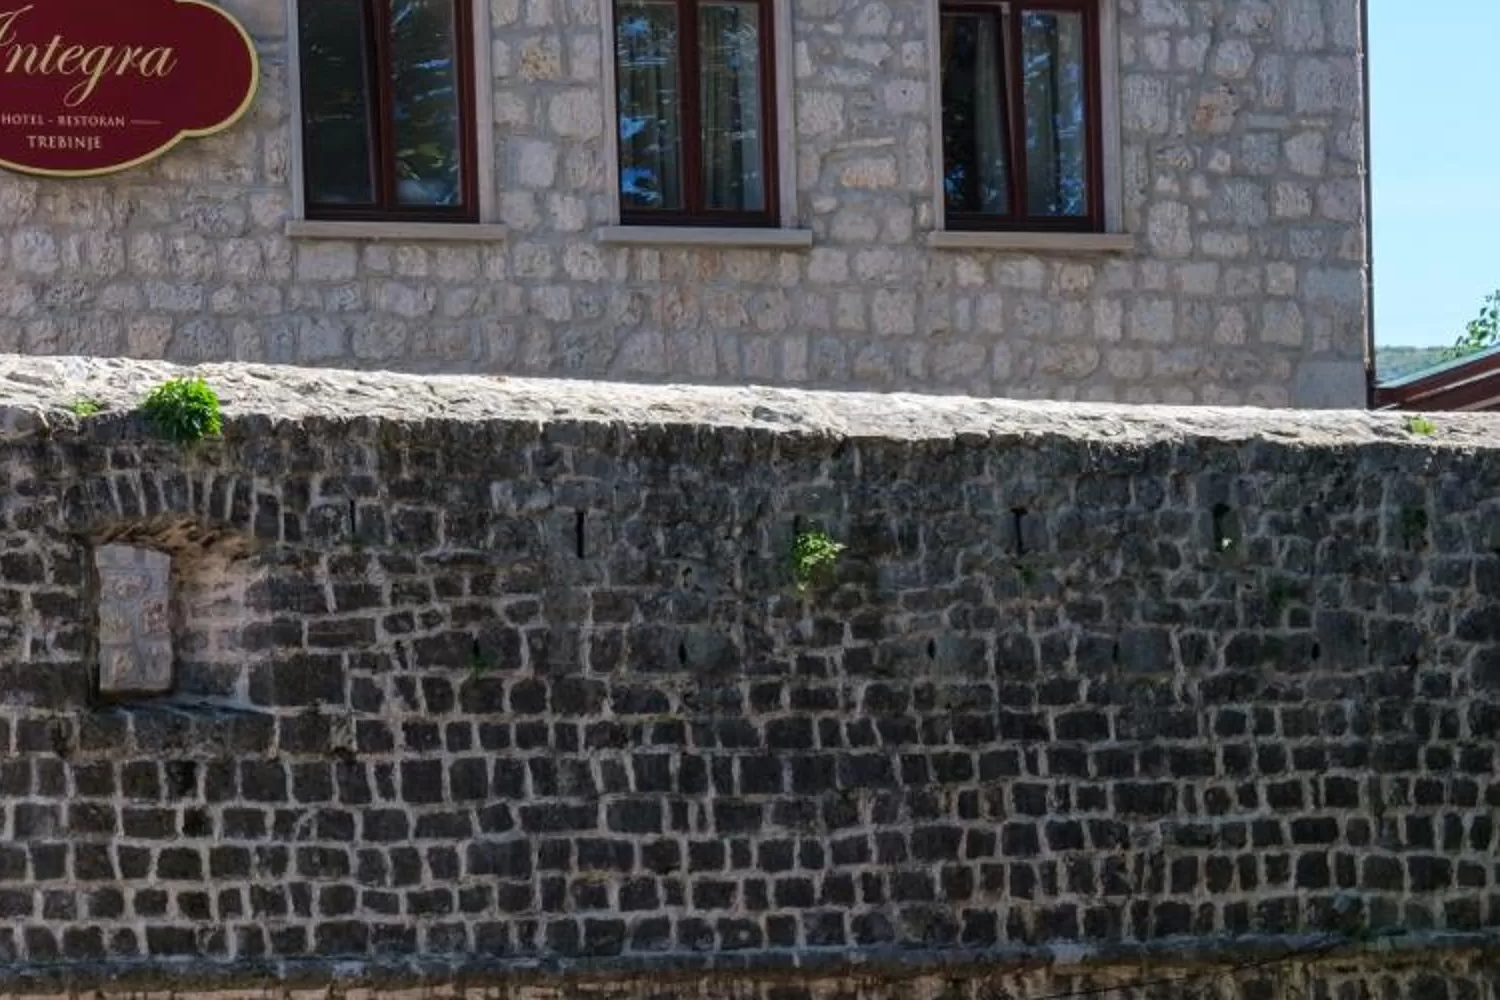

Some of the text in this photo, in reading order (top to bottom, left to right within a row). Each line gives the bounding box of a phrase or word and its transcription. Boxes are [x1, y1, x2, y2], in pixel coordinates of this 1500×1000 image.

[1, 113, 44, 126] HOTEL
[57, 115, 126, 128] RESTORAN
[26, 135, 101, 151] TREBINJE
